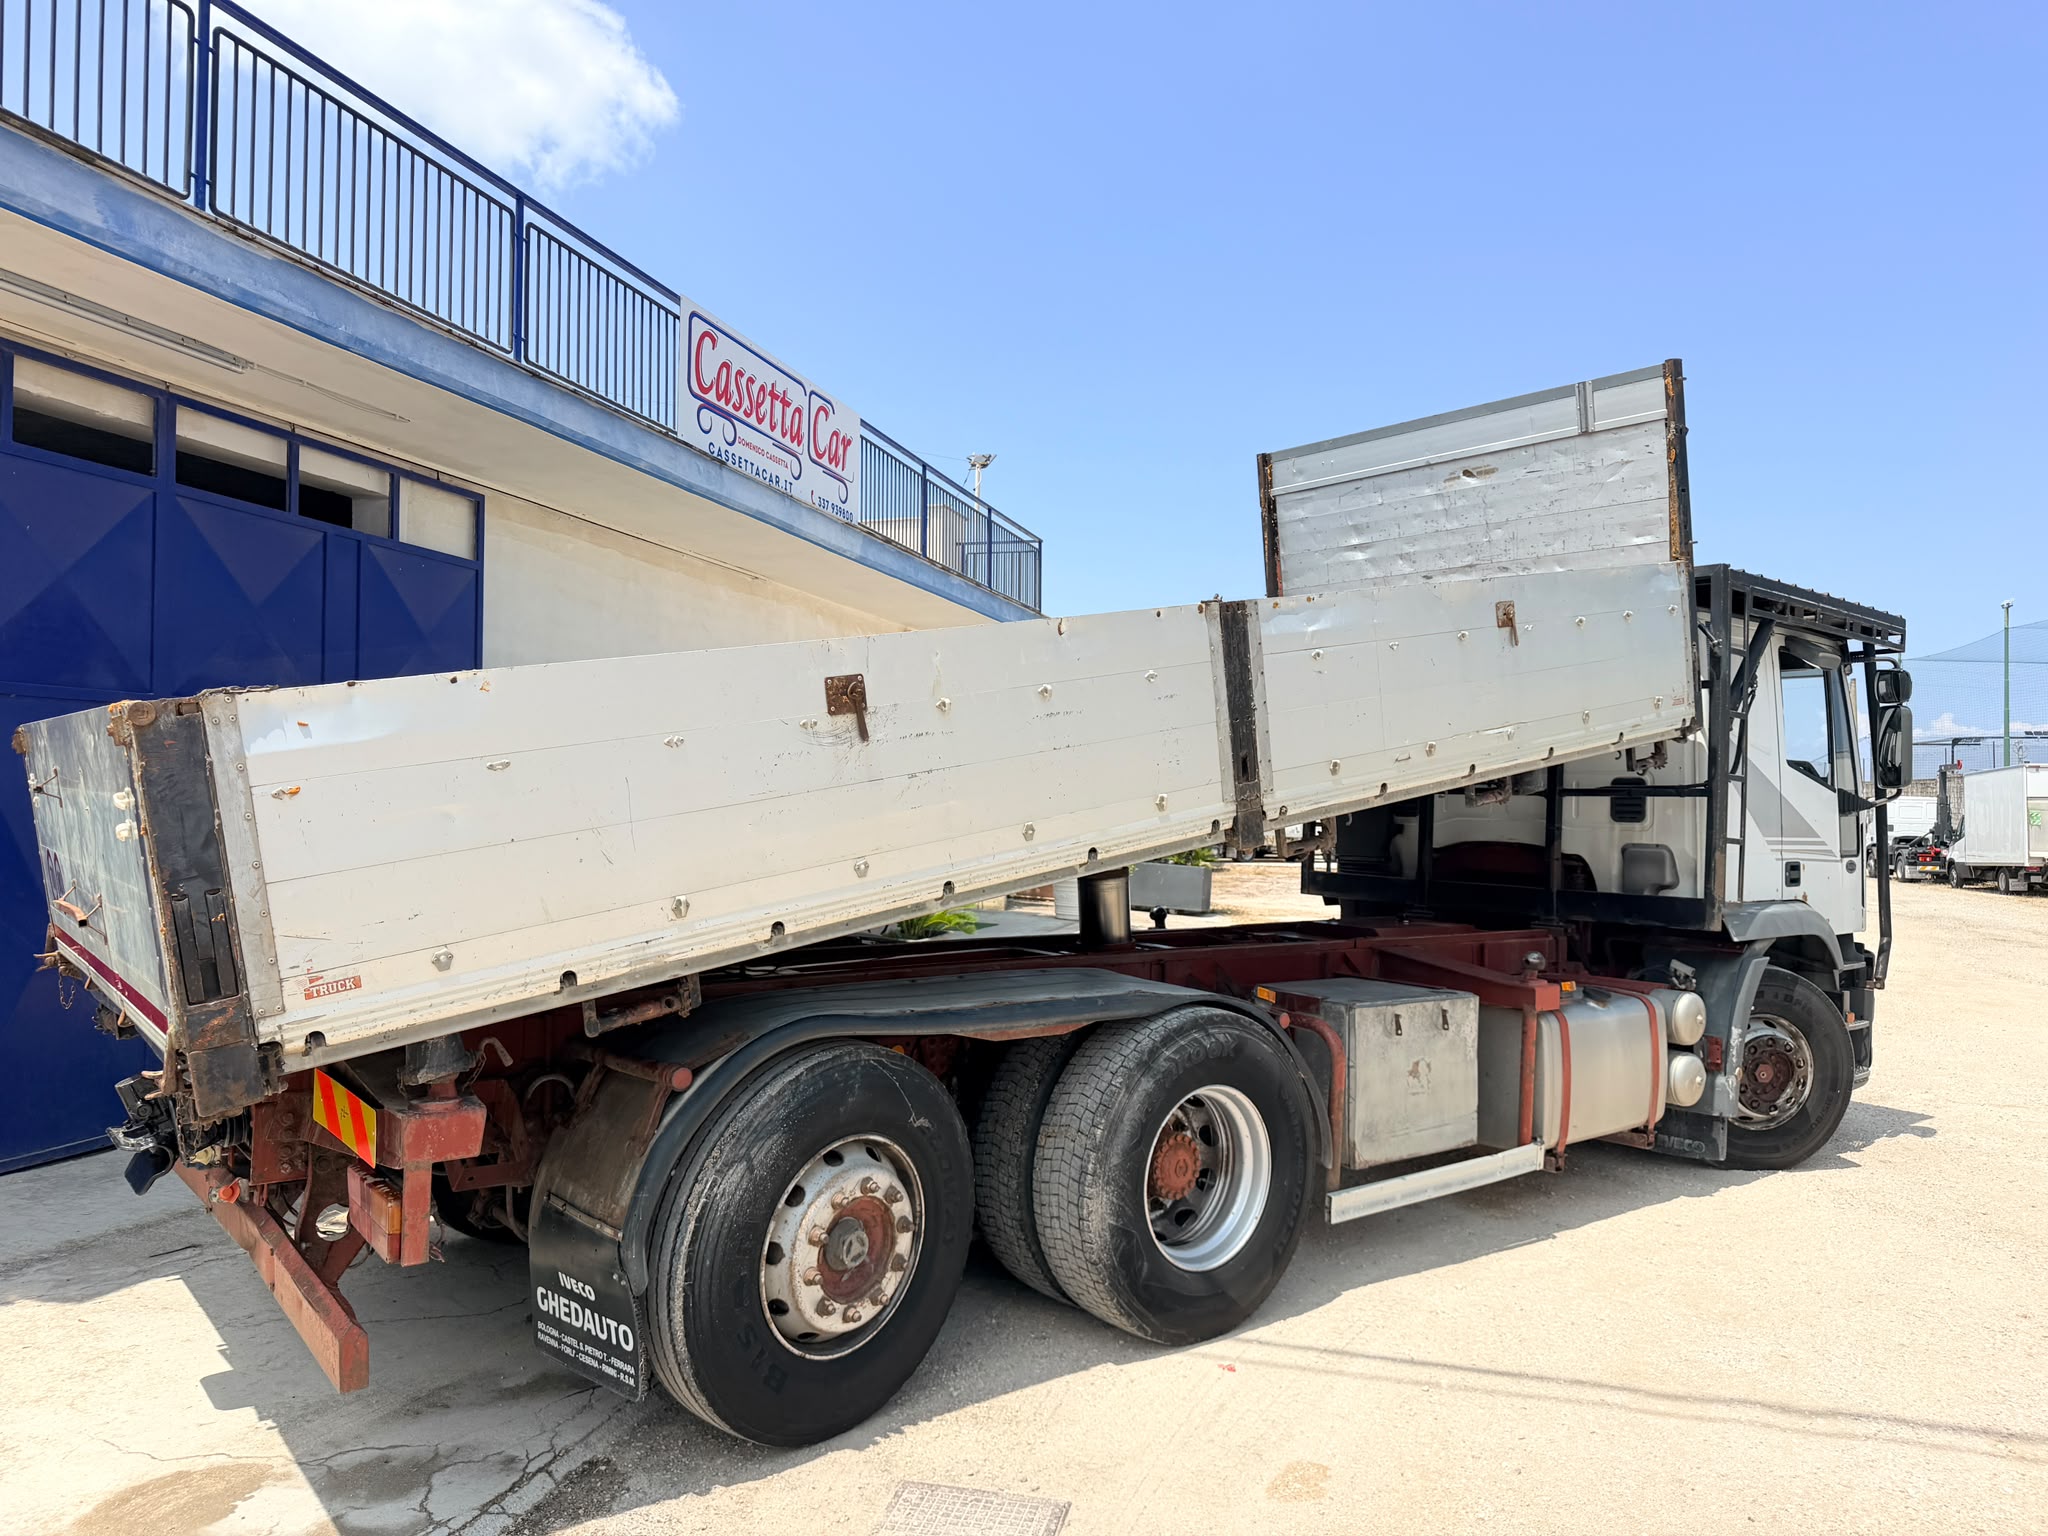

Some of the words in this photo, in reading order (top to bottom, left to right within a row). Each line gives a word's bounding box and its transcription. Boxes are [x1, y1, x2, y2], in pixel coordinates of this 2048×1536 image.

[695, 329, 804, 447] Cassetta
[813, 405, 854, 471] Car
[708, 442, 793, 493] CASSETTACAR.IT
[738, 436, 765, 457] DOMENICO
[766, 451, 789, 469] CASSETTA
[817, 496, 830, 510] 337
[309, 978, 357, 998] TRUCK
[558, 1271, 596, 1301] IVECO
[536, 1286, 634, 1351] GHEDAUTO
[537, 1320, 559, 1338] BOLOGNA
[561, 1333, 579, 1349] CASTEL
[585, 1344, 603, 1360] PIETRO
[611, 1356, 635, 1375] FERRARA
[537, 1331, 559, 1349] RAVENNA
[578, 1352, 599, 1369] CESENA
